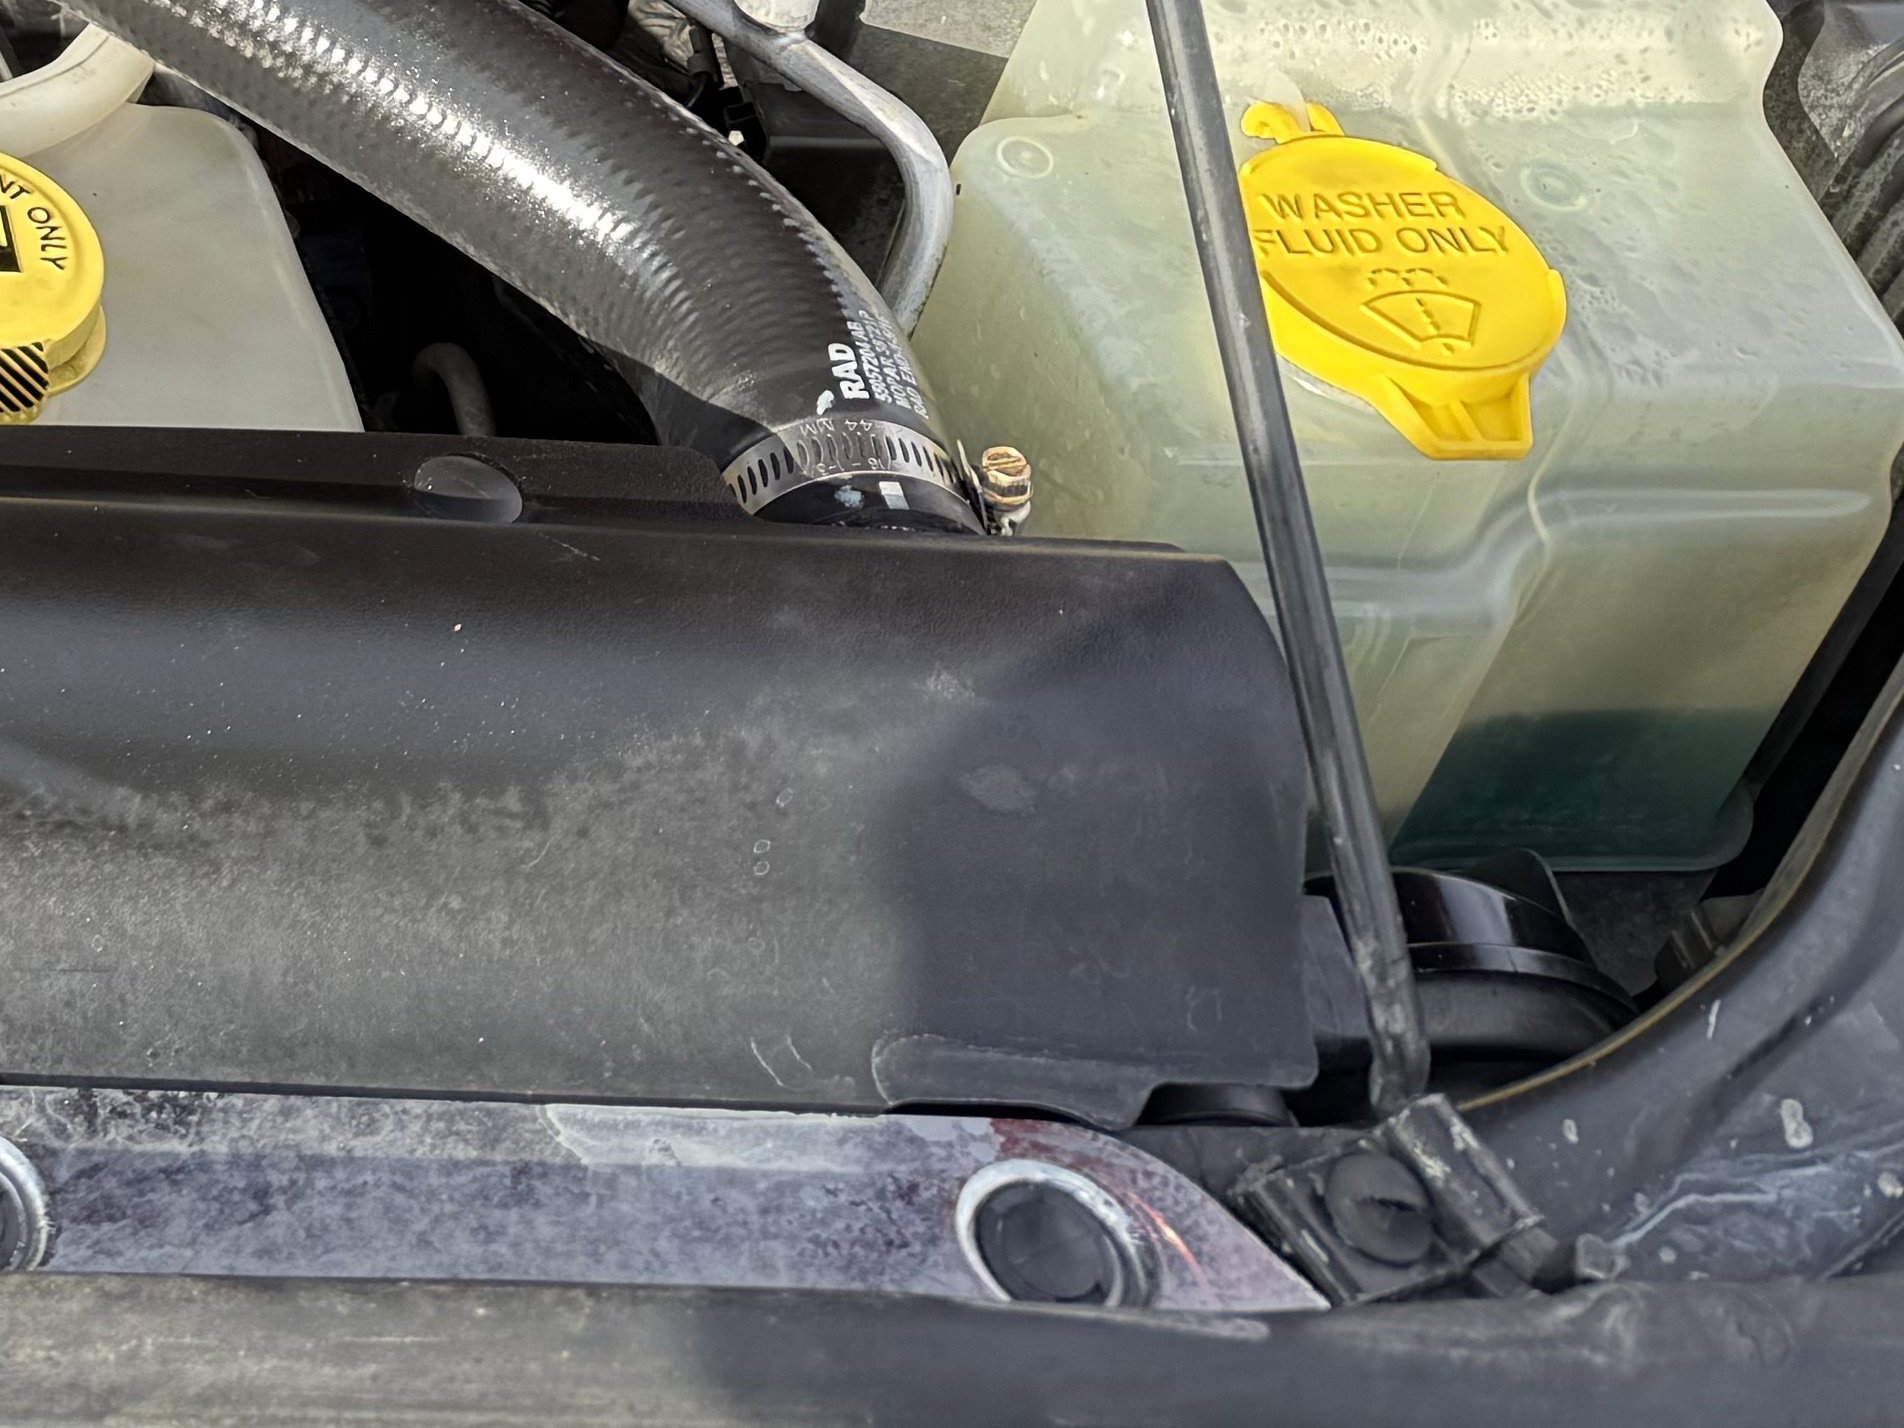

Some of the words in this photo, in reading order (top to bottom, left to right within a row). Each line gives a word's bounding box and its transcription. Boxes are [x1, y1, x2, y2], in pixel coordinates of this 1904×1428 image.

[1258, 190, 1463, 221] WASHER
[27, 206, 68, 271] ONLY
[1255, 227, 1382, 255] FLUID
[1396, 226, 1511, 255] ONLY
[828, 343, 870, 399] RAD
